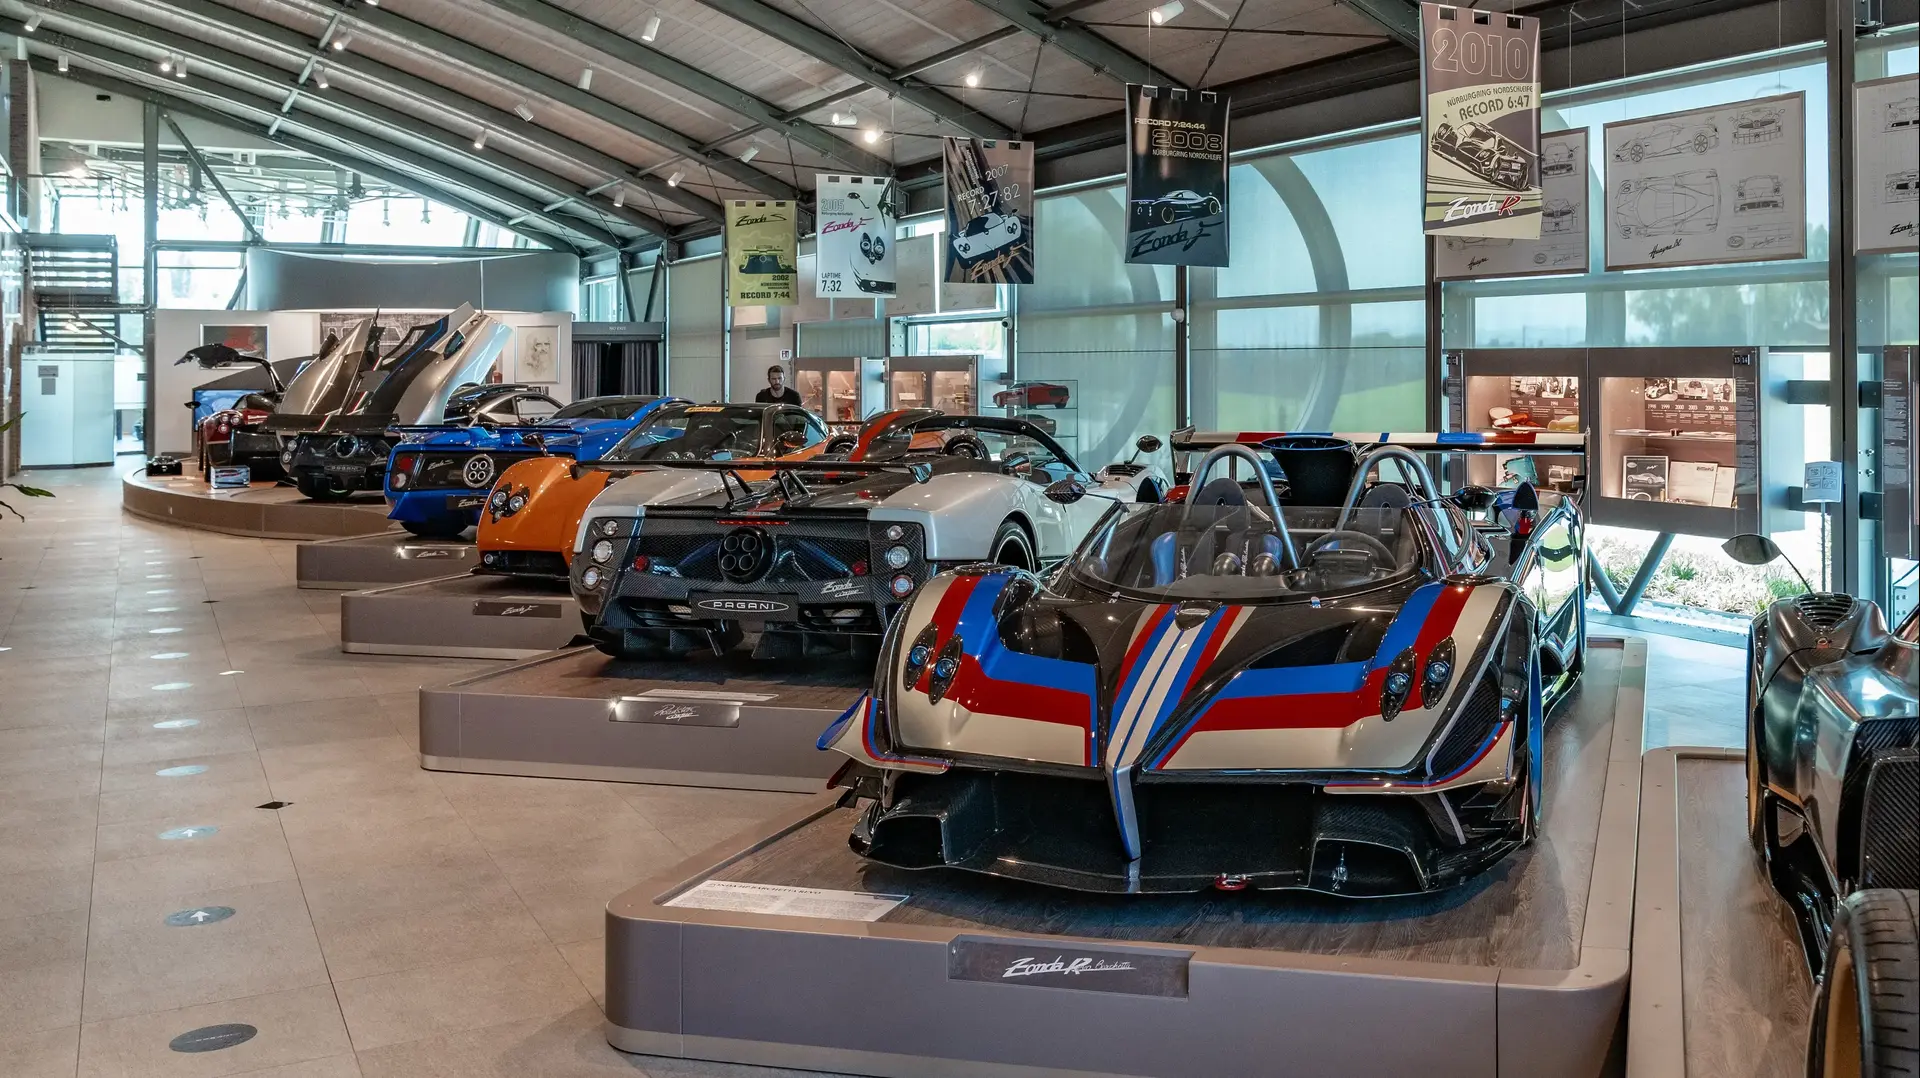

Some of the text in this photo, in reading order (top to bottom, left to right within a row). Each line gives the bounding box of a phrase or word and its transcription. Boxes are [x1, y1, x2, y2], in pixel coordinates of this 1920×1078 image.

[1432, 28, 1529, 80] 2010
[1447, 85, 1533, 107] NÜRBURGRING NORDSCHLEIFE
[1459, 95, 1530, 120] RECORD 6:47
[1134, 118, 1206, 130] RECORD 7:24:44
[1152, 128, 1223, 152] 2008
[1152, 149, 1223, 161] NÜRBURGRING NORDSCHLEIFE
[985, 164, 1009, 182] 2007
[957, 186, 985, 202] RECORD
[967, 183, 1021, 215] 7:27:82
[820, 199, 845, 212] 2005
[1444, 193, 1522, 222] Zonda R
[735, 214, 767, 227] Zonda
[821, 218, 854, 234] Zonda
[1131, 222, 1189, 258] Zonda
[970, 250, 1005, 281] Zonda
[821, 280, 842, 292] 7:32
[821, 581, 853, 594] Zonda
[713, 601, 775, 610] PAGANI
[1002, 955, 1065, 978] Zonda
